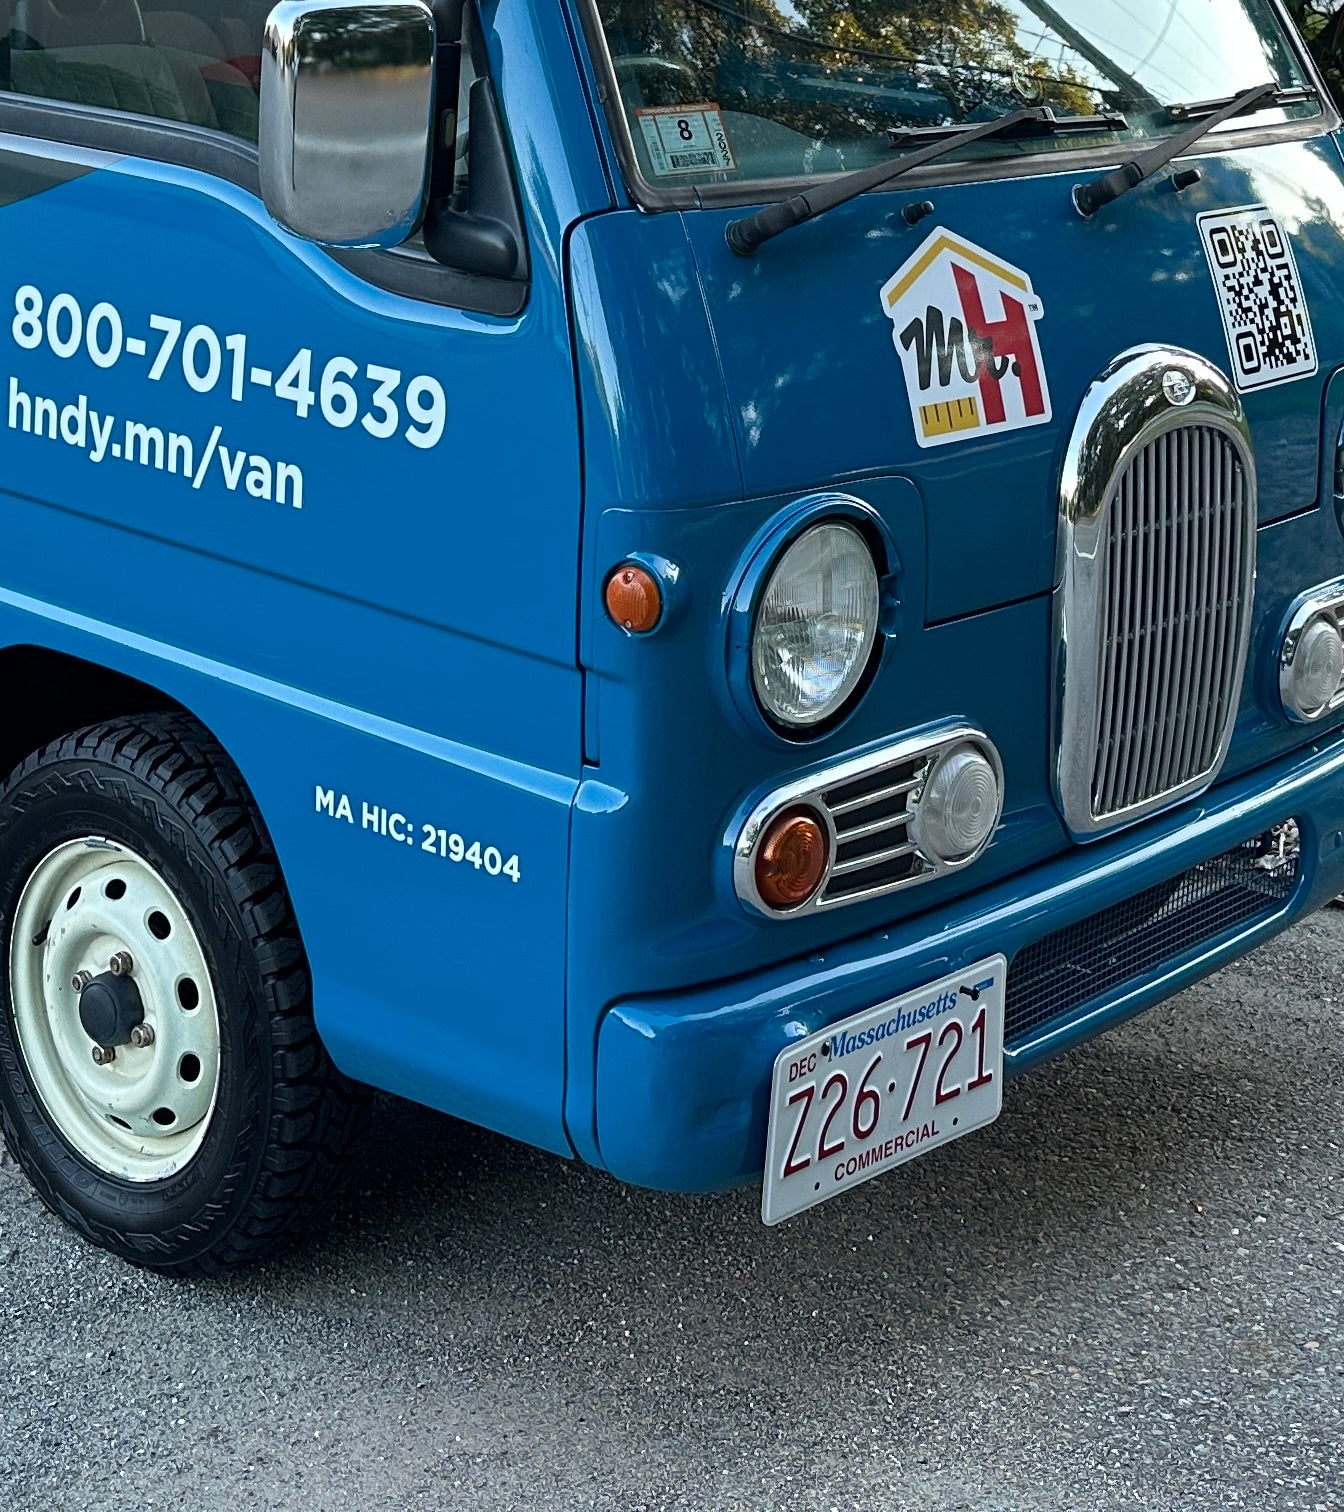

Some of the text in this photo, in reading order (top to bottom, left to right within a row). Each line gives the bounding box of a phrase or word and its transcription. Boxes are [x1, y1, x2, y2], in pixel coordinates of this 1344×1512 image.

[677, 119, 693, 141] 8
[11, 284, 447, 449] 800-701-4639
[7, 376, 304, 509] hndy.mn/van
[315, 785, 521, 883] MA HIC: 219404
[827, 990, 957, 1063] Massachusetts
[788, 1052, 817, 1083] DEC
[834, 1119, 940, 1182] COMMERCIAL
